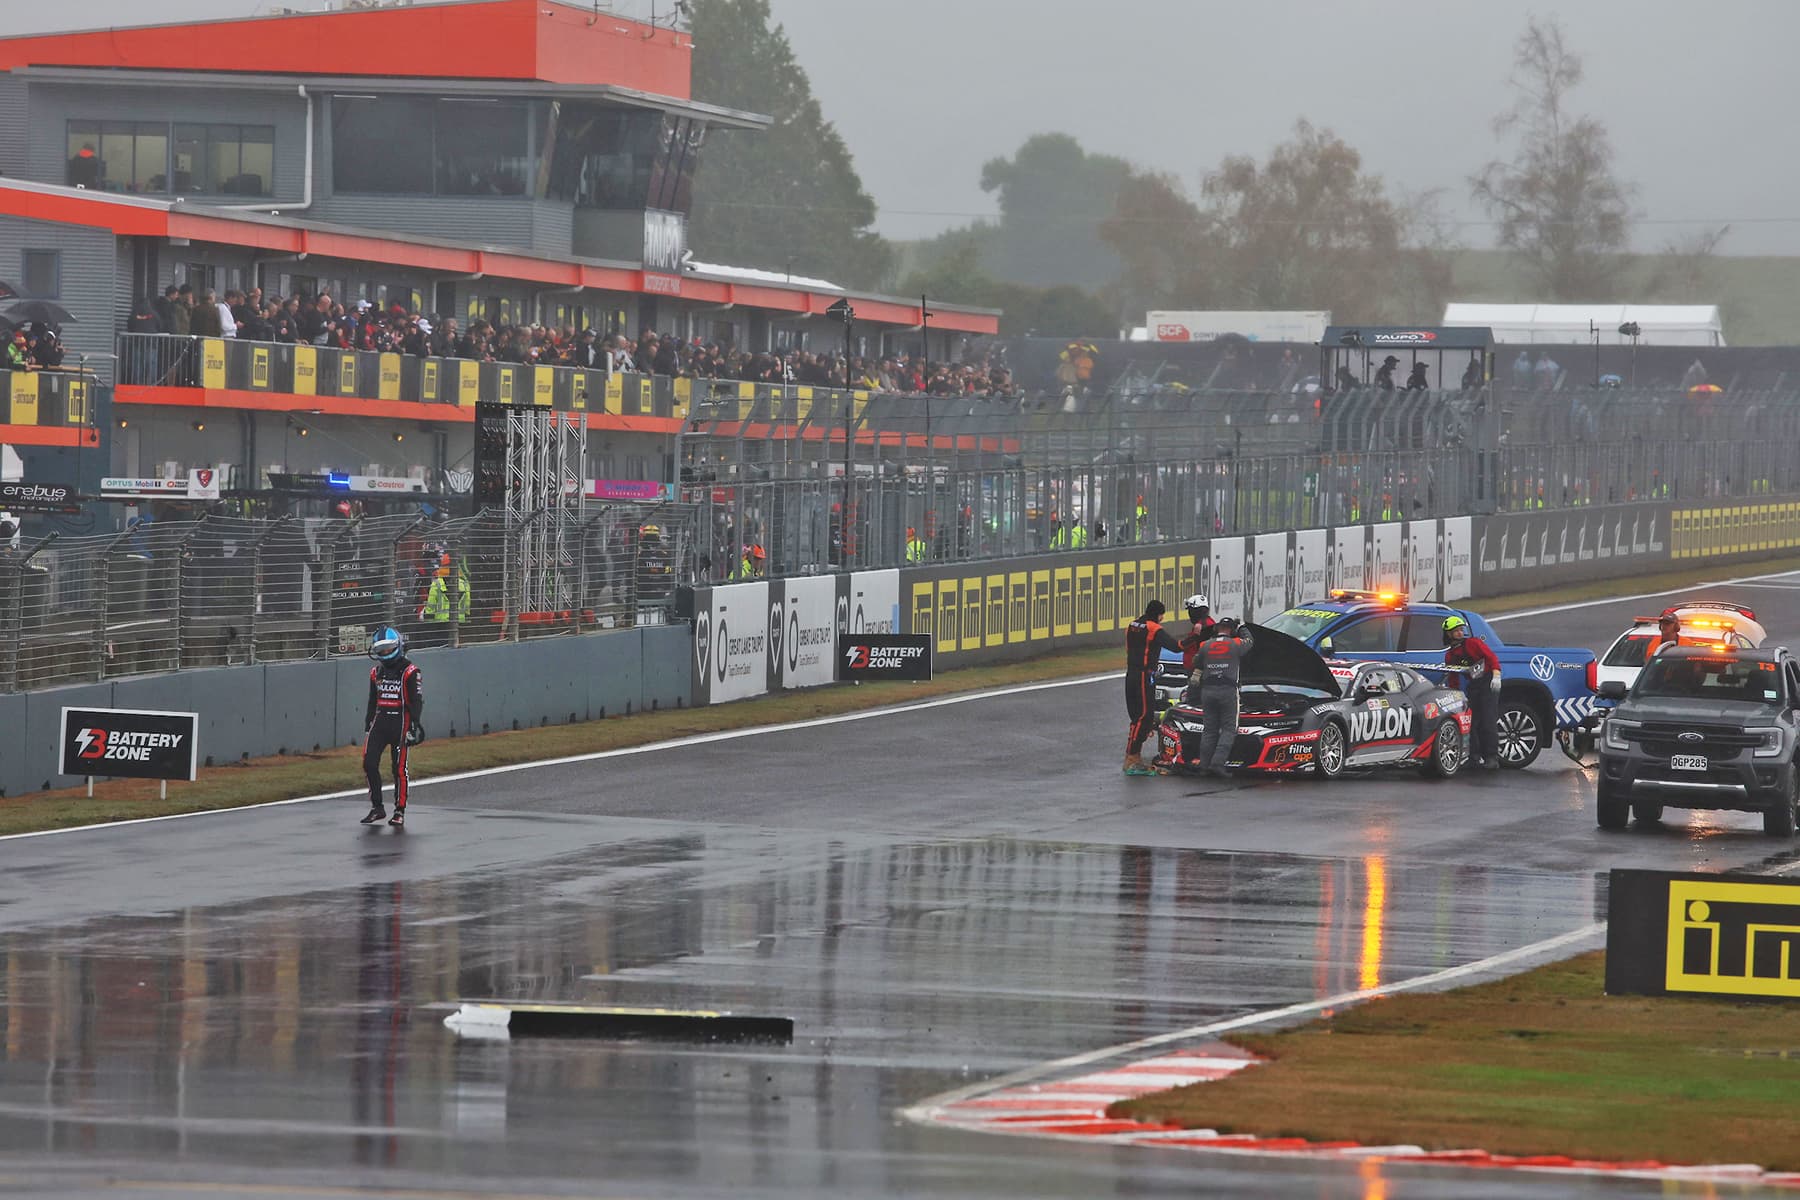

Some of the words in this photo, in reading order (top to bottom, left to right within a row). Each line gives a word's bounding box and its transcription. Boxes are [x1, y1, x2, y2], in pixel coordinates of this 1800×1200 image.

[1159, 326, 1183, 336] SCF
[3, 484, 67, 497] erebus
[870, 646, 924, 658] BATTERY
[868, 657, 903, 668] ZONE
[1758, 662, 1776, 672] T3
[1351, 707, 1413, 743] NULON
[108, 731, 183, 748] BATTERY
[1269, 736, 1294, 744] ISUZU
[104, 746, 152, 761] ZONE
